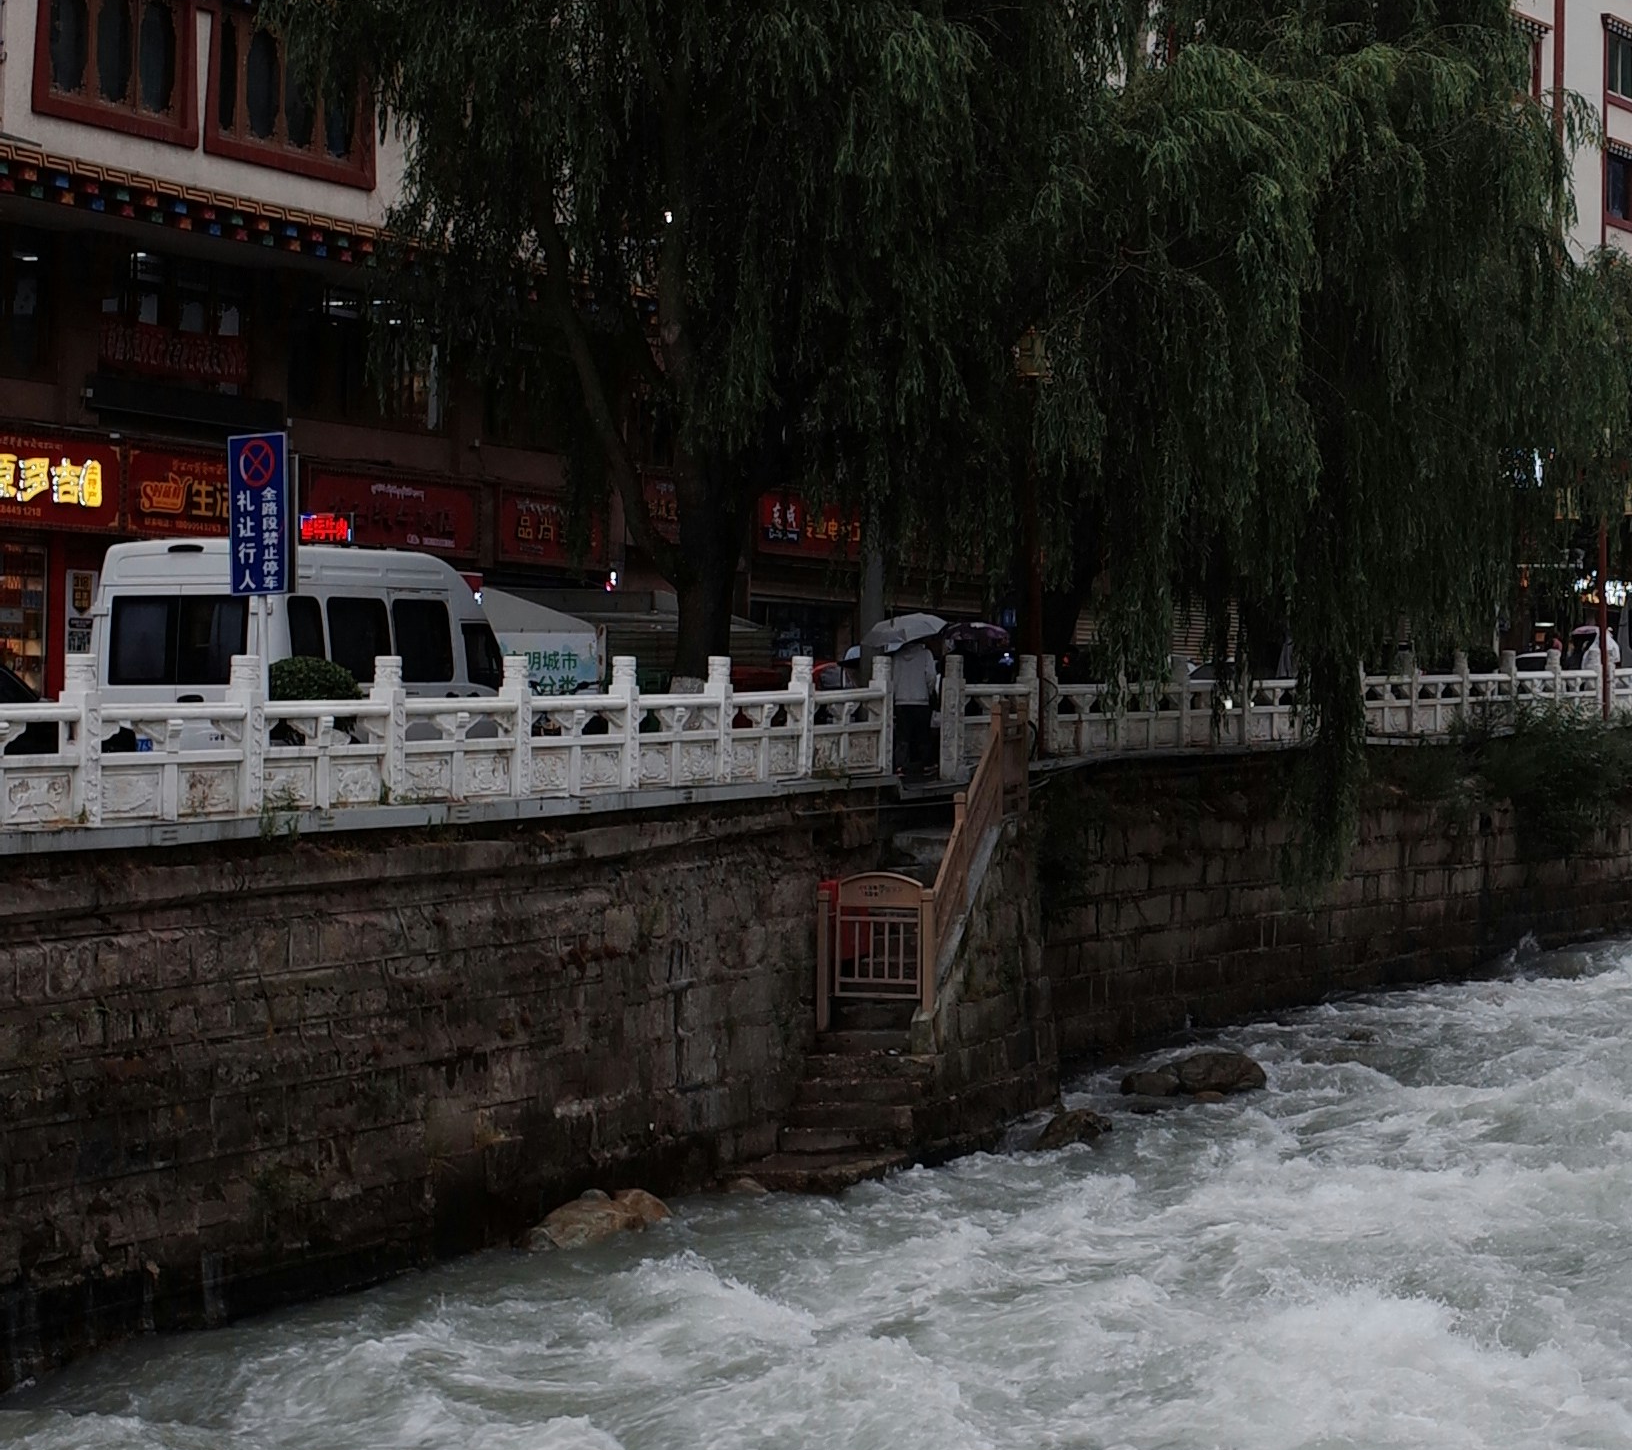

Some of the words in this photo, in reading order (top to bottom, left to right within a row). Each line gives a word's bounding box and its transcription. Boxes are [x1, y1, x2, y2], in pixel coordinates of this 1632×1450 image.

[237, 490, 256, 590] 礼让行人
[261, 486, 279, 590] 全路段禁止停车
